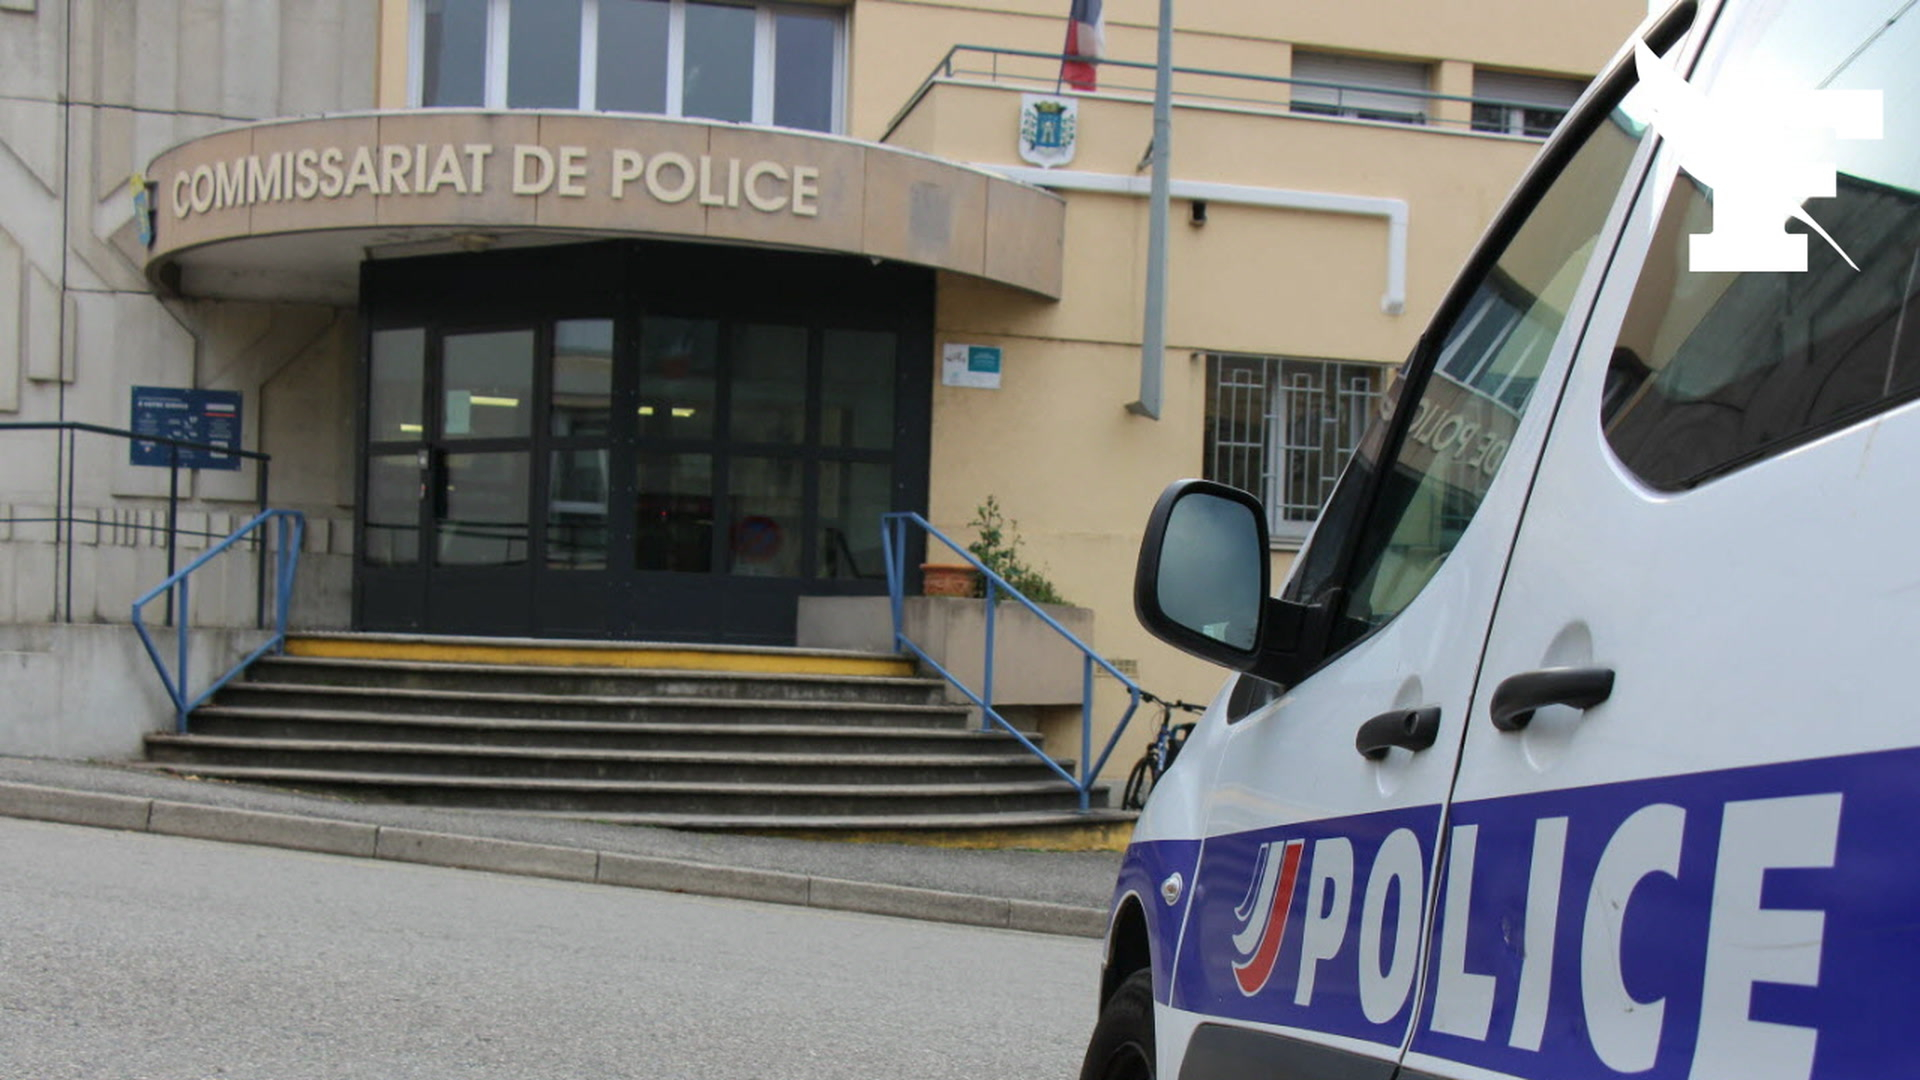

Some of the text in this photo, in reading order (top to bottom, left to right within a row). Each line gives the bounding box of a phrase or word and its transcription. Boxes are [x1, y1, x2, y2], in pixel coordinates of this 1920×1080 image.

[171, 144, 819, 219] COMMISSARIAT DE POLICE
[1294, 791, 1843, 1080] POLICE
